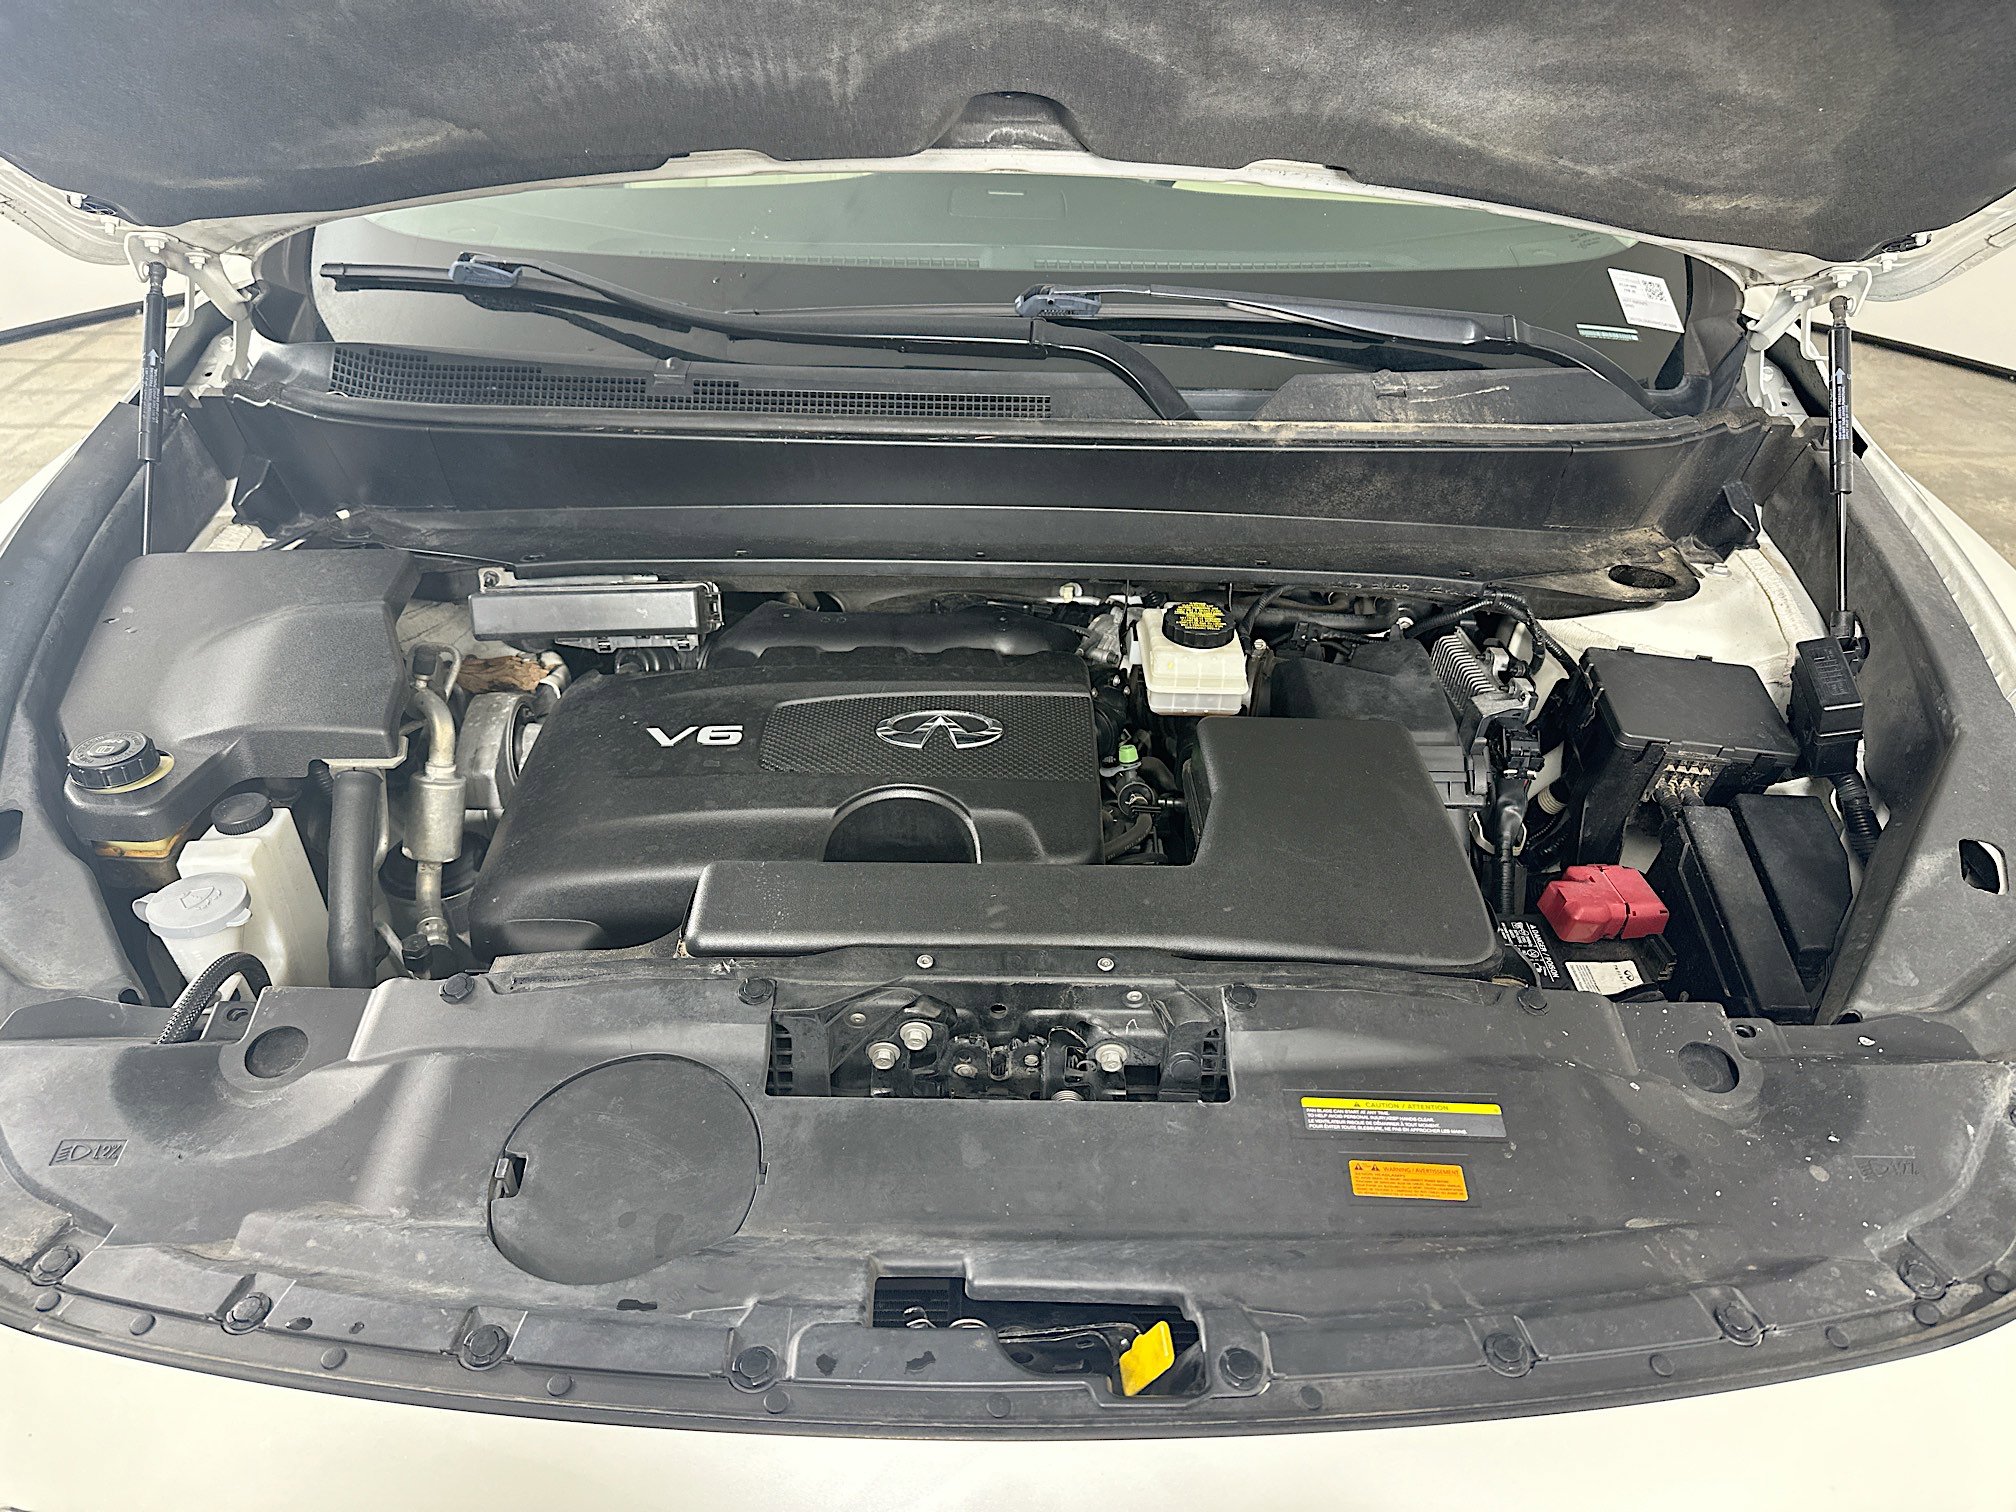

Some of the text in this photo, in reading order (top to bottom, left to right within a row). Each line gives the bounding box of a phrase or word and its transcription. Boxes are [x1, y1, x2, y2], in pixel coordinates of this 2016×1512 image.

[646, 724, 744, 748] V6
[1532, 930, 1547, 952] DANGER
[1545, 957, 1559, 978] POISON
[1407, 1103, 1449, 1111] ATTENTION
